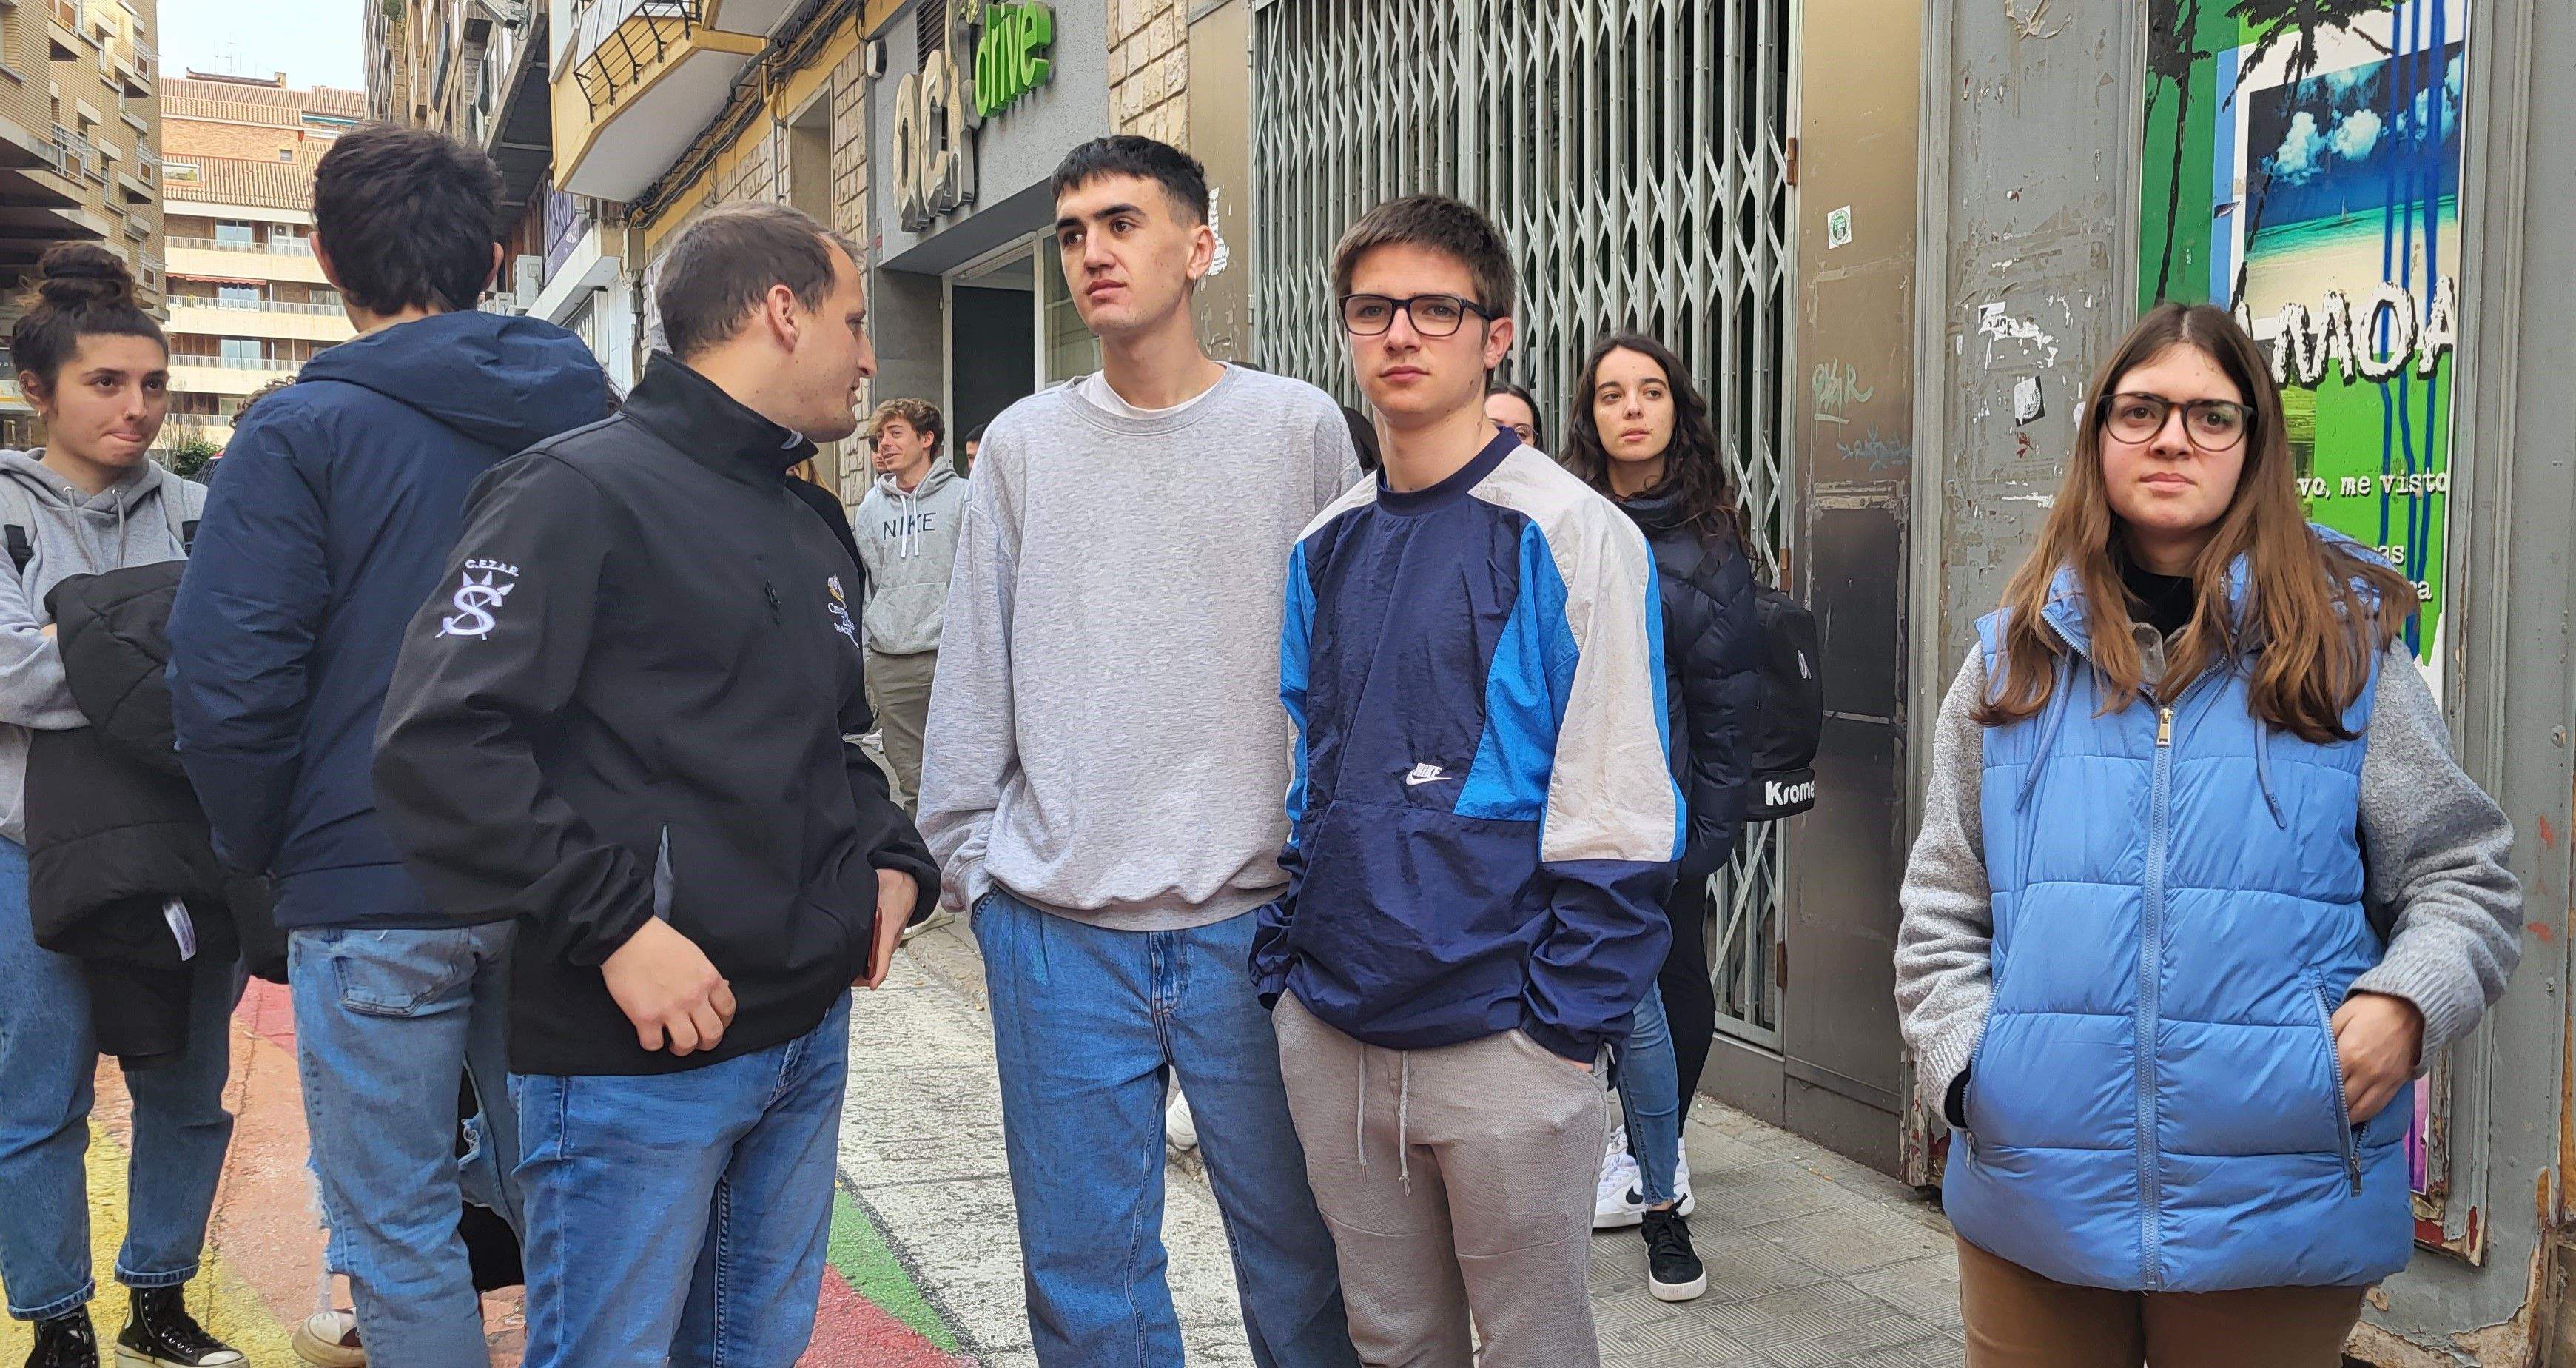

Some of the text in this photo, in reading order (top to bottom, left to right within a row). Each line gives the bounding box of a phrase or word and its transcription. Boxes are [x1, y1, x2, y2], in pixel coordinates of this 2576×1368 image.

[975, 1, 1048, 117] drive
[2235, 275, 2455, 385] MOA
[2340, 475, 2371, 495] me
[2379, 467, 2450, 494] visto
[884, 512, 936, 540] NIKE
[1413, 763, 1443, 779] NIKE
